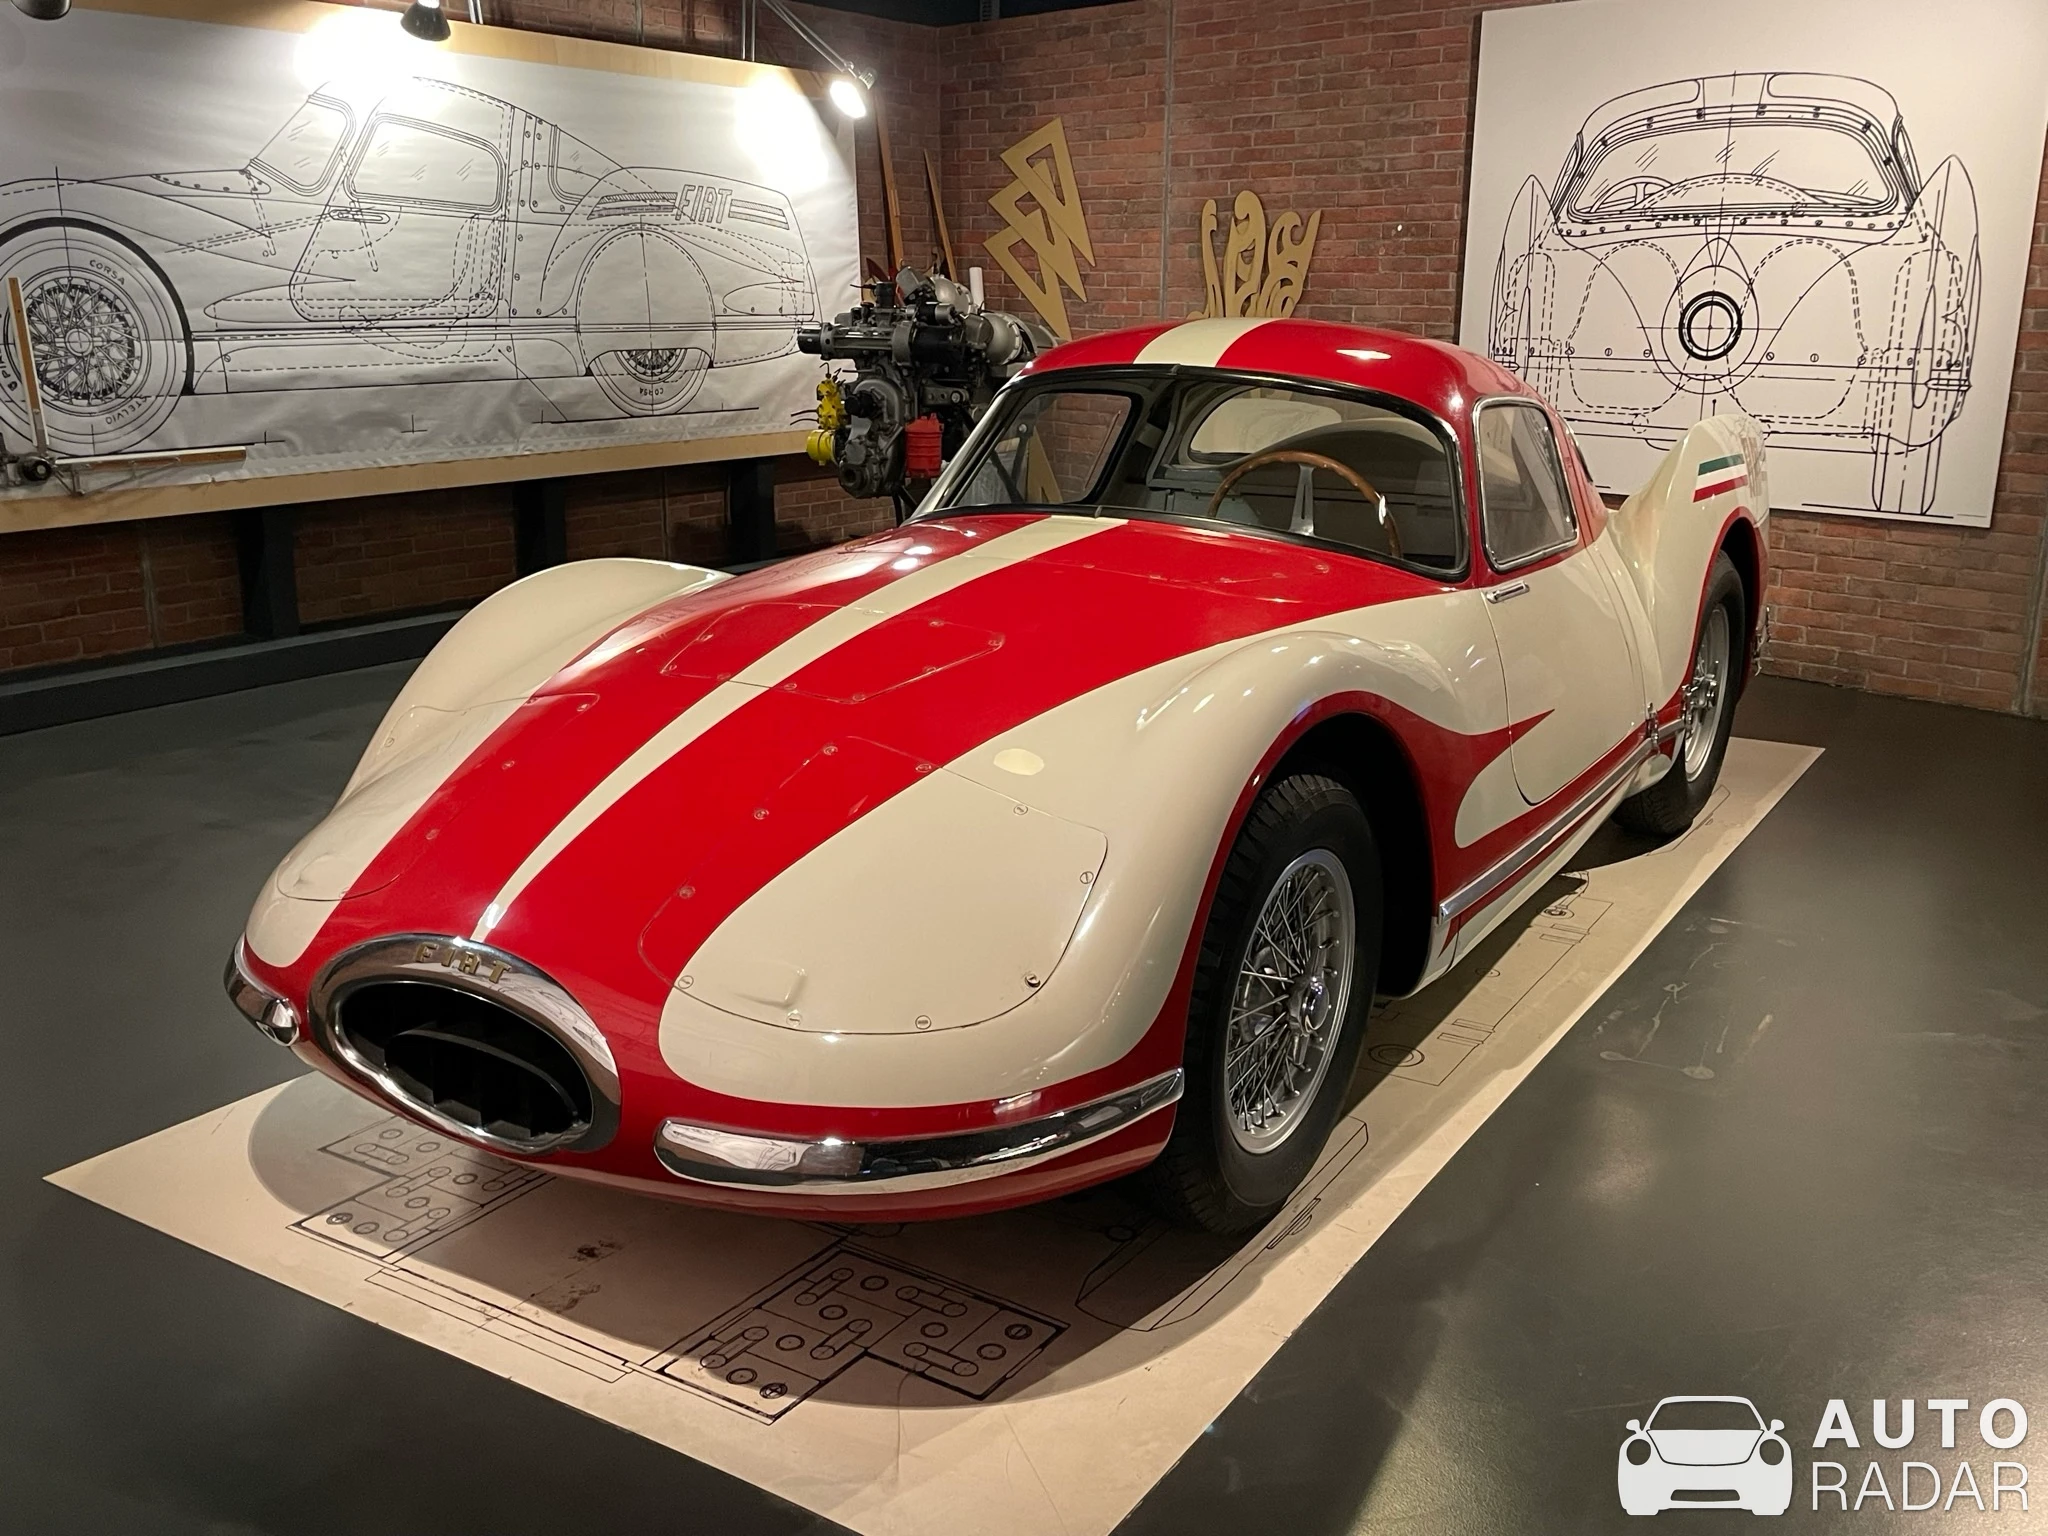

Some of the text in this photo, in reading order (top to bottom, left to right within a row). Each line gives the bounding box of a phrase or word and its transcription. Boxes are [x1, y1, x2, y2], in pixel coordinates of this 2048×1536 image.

[675, 183, 733, 224] FIAT
[89, 259, 125, 286] CORSA
[639, 387, 664, 397] CORSA
[105, 395, 148, 425] STELVIO
[415, 941, 513, 984] FIAT
